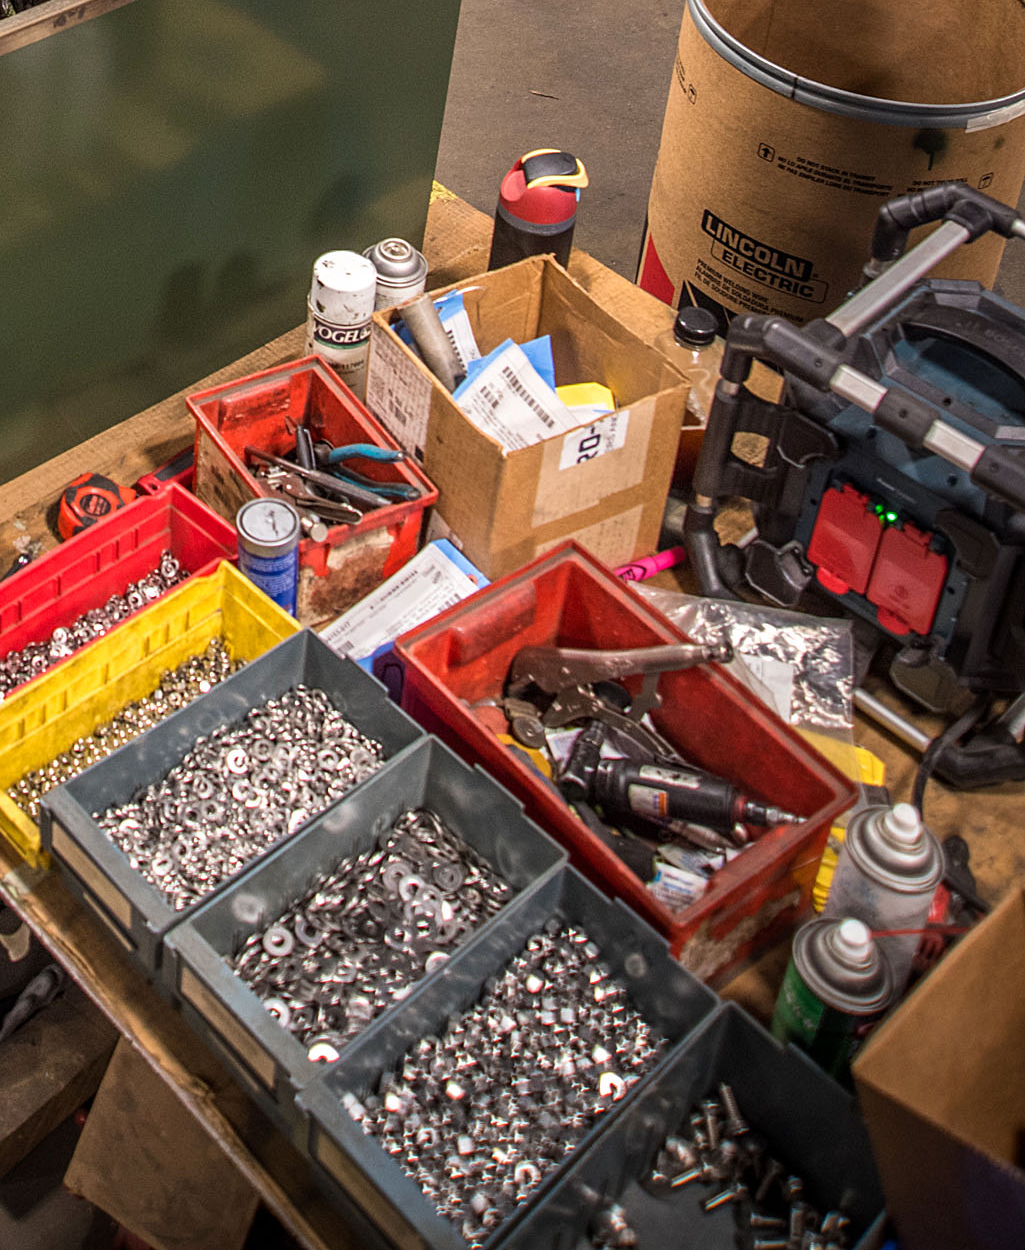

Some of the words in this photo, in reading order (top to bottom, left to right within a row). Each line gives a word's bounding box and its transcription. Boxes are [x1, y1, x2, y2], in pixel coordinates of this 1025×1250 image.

[697, 258, 723, 280] PREMIUM
[705, 214, 807, 278] LINCOLN
[722, 249, 814, 298] ELECTRIC
